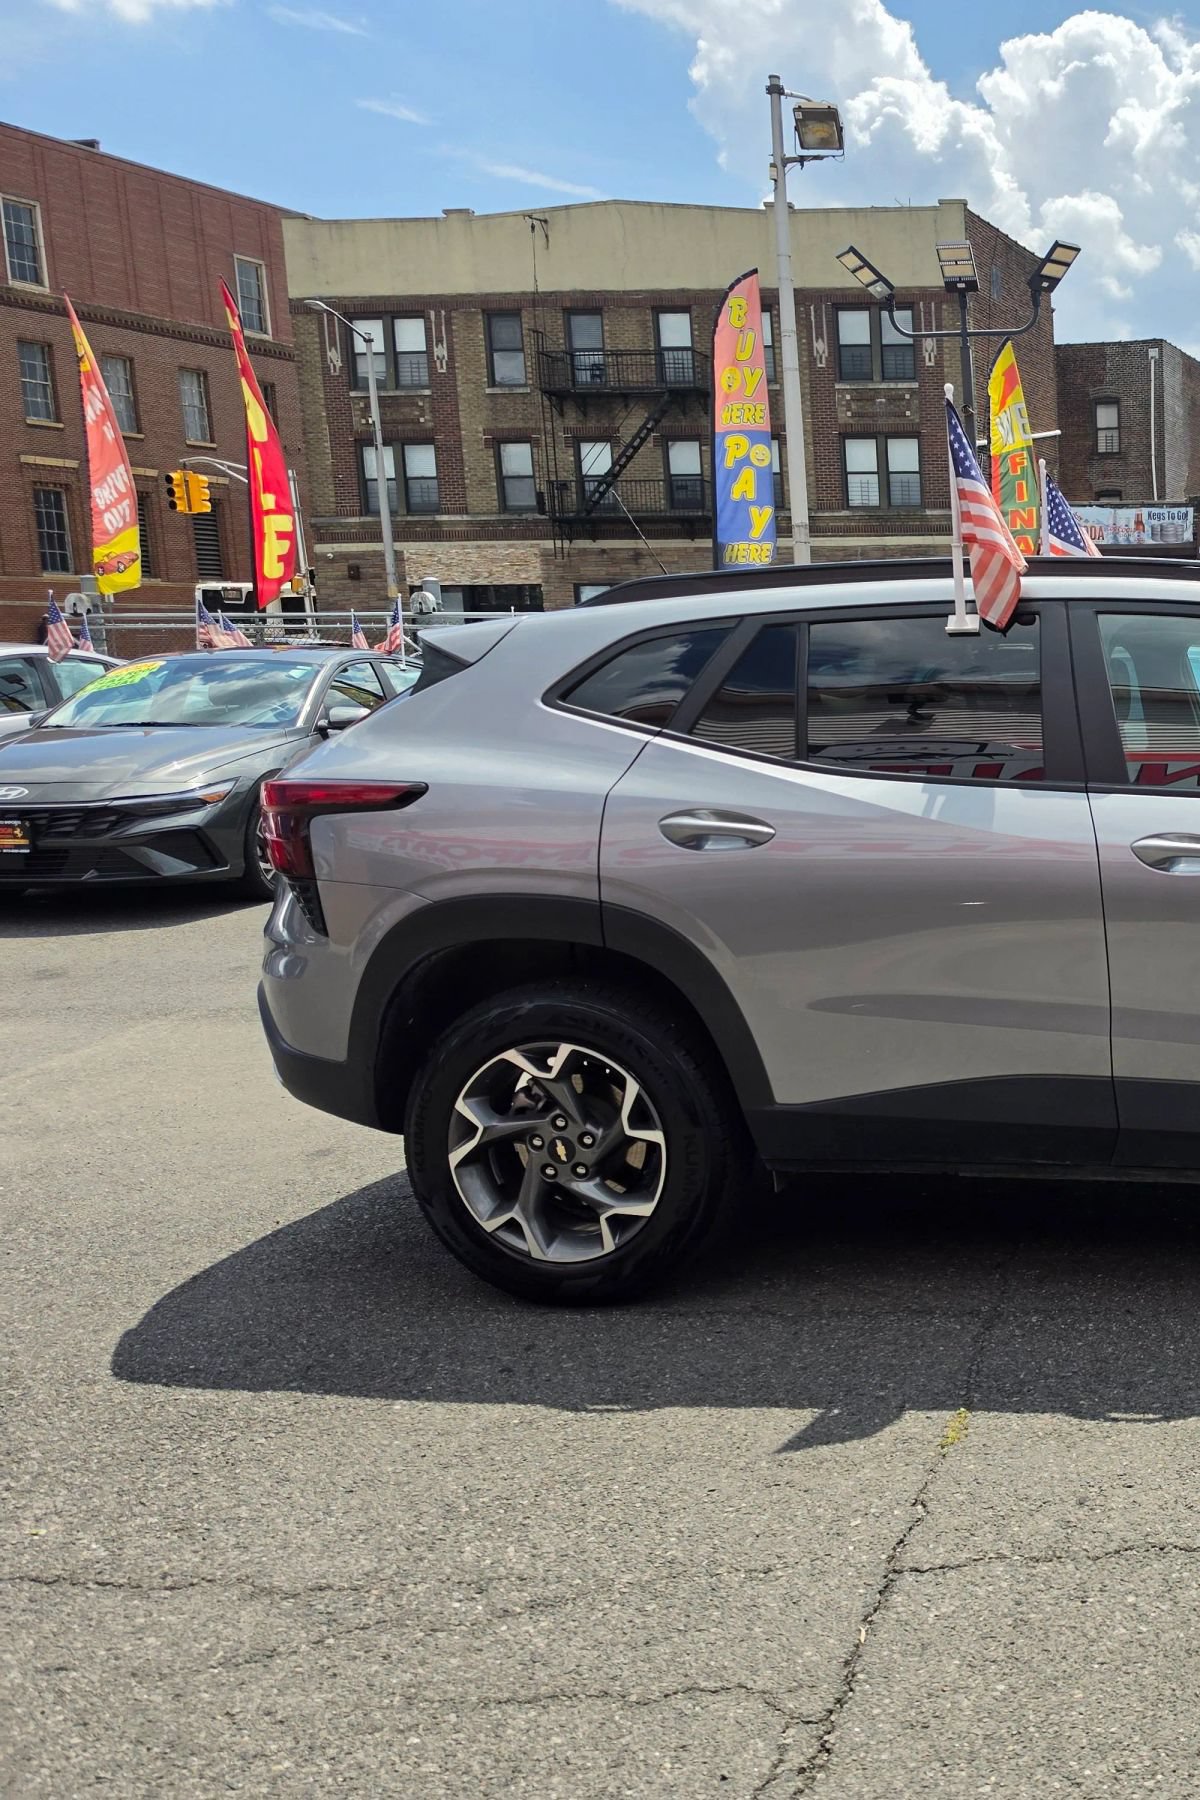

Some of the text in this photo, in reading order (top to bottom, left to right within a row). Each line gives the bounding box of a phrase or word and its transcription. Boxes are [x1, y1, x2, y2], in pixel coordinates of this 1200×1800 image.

[721, 402, 766, 425] HERE
[995, 402, 1031, 446] WE
[102, 498, 131, 534] OUT
[1147, 510, 1166, 521] Kegs
[1167, 510, 1176, 520] To
[723, 543, 773, 564] HERE
